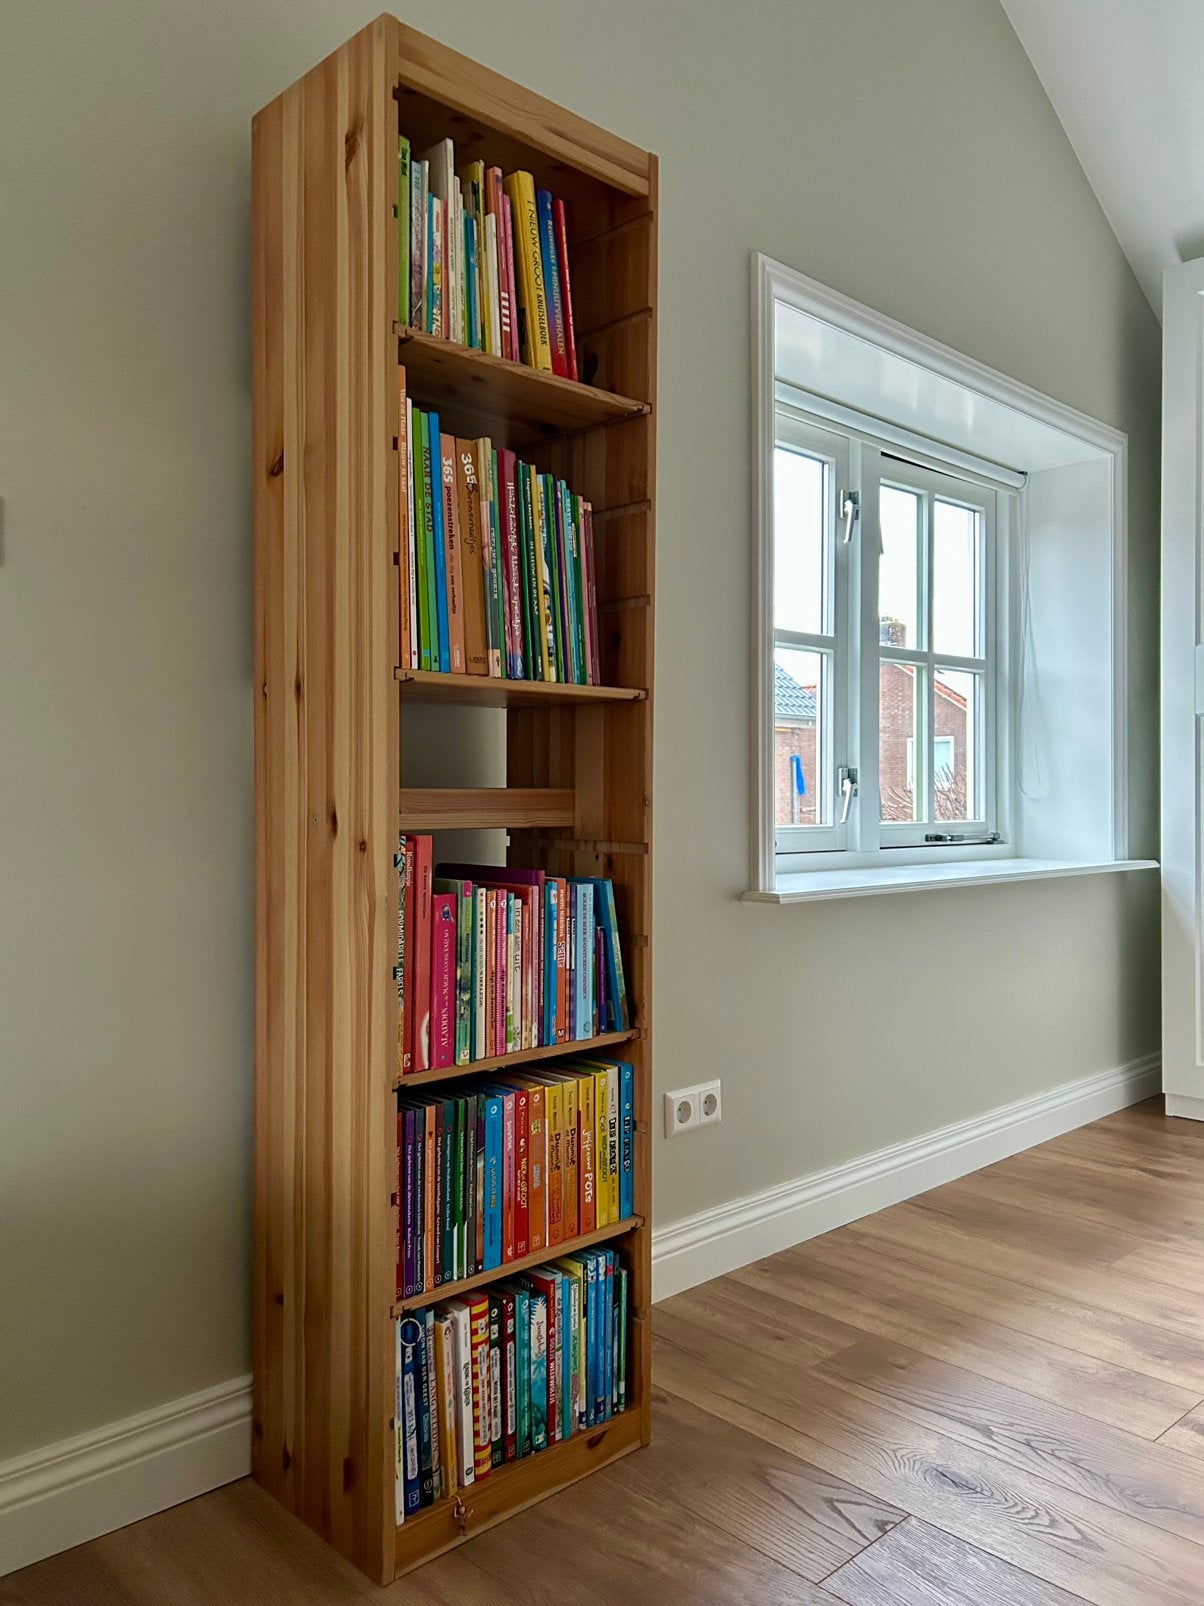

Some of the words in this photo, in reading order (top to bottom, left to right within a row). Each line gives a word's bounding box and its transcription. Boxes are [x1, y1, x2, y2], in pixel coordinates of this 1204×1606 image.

[529, 209, 540, 247] NIEUW
[532, 251, 544, 292] GROOT
[537, 293, 549, 347] KNUTSELBOEK
[423, 447, 431, 479] NAAR
[443, 457, 453, 484] 365
[461, 452, 478, 485] 365
[424, 483, 432, 498] DE
[425, 502, 433, 533] STAD
[446, 486, 457, 550] poezenstreken
[464, 483, 478, 555] Berenverhaaltjes
[405, 851, 413, 888] Roodkapje
[440, 1007, 450, 1048] ALADDIN
